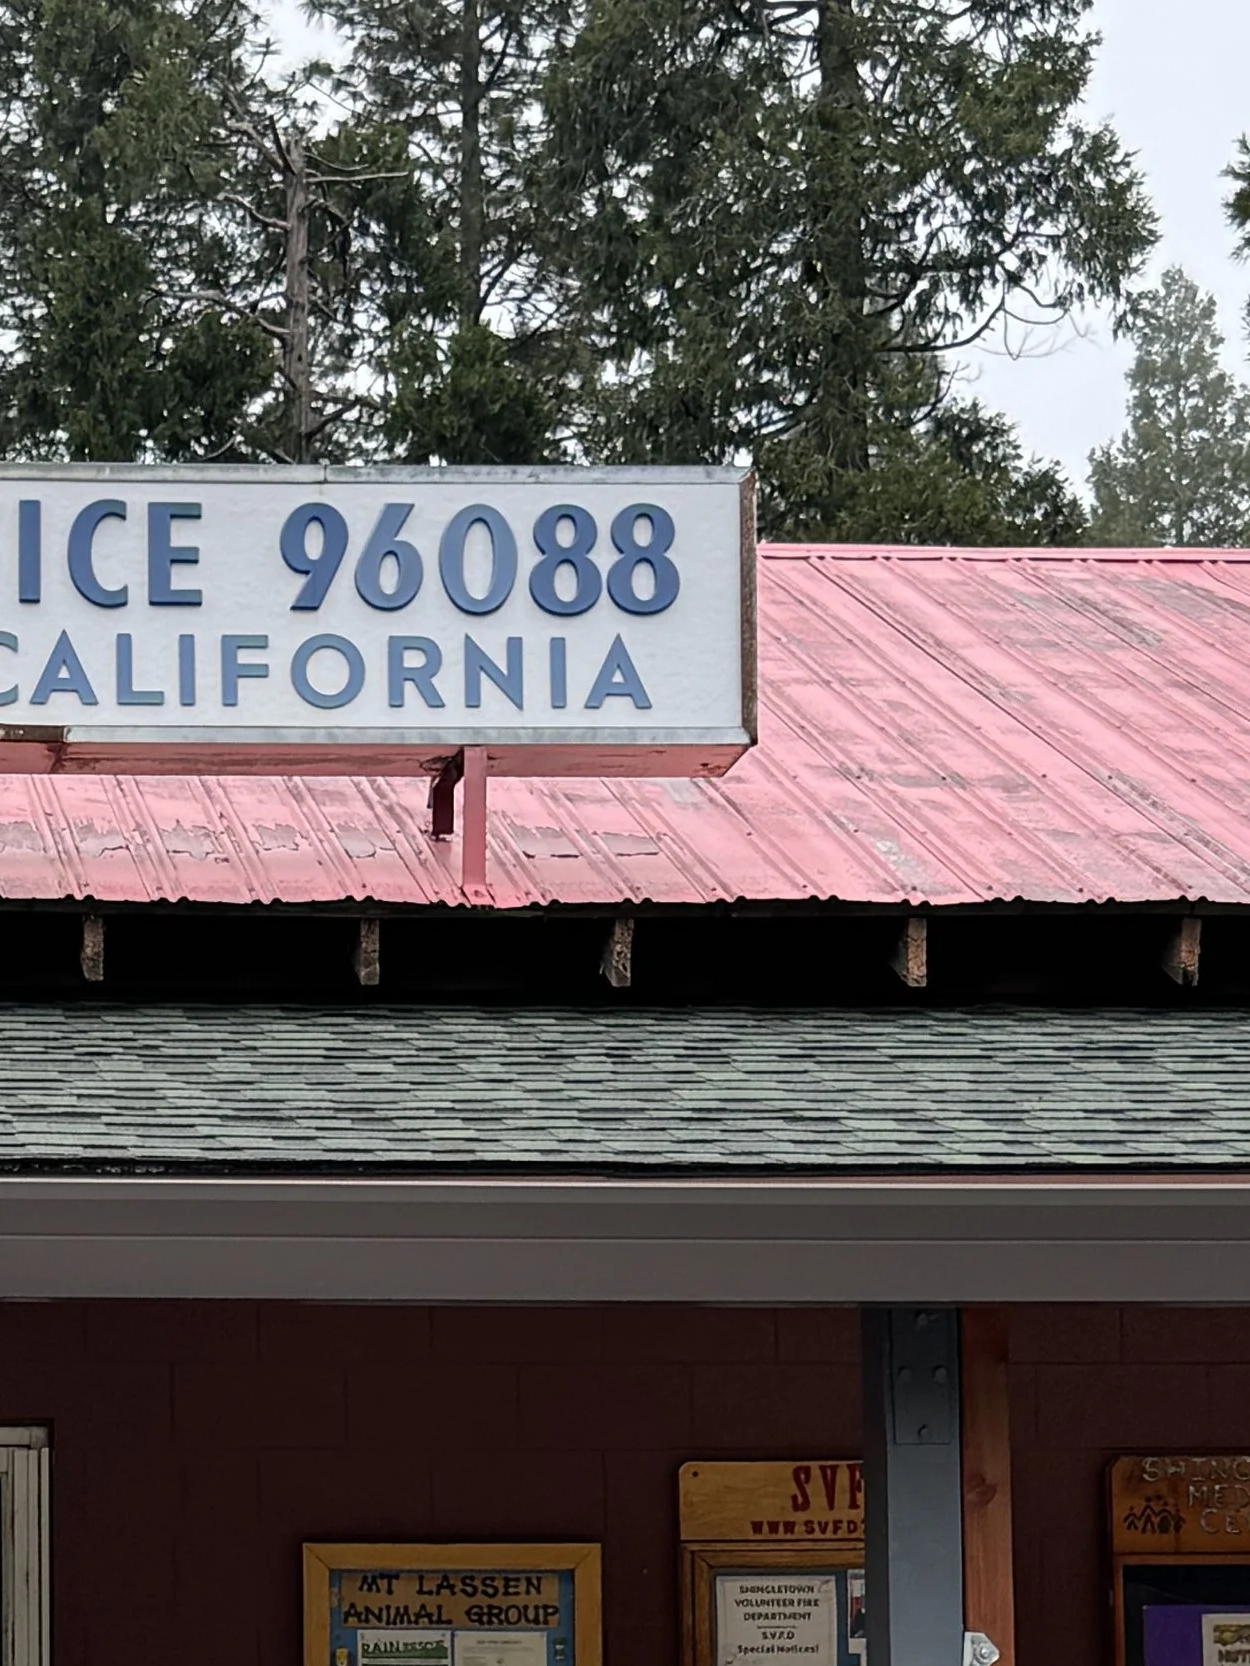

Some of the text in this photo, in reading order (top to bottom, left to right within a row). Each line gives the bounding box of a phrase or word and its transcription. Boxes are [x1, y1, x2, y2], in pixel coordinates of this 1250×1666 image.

[278, 502, 681, 615] 96088
[358, 1573, 544, 1599] MT LASSEN
[342, 1602, 560, 1626] ANIMAL GROUP
[734, 1598, 795, 1607] VOLUNTEER
[743, 1612, 812, 1621] DEPARTMENT
